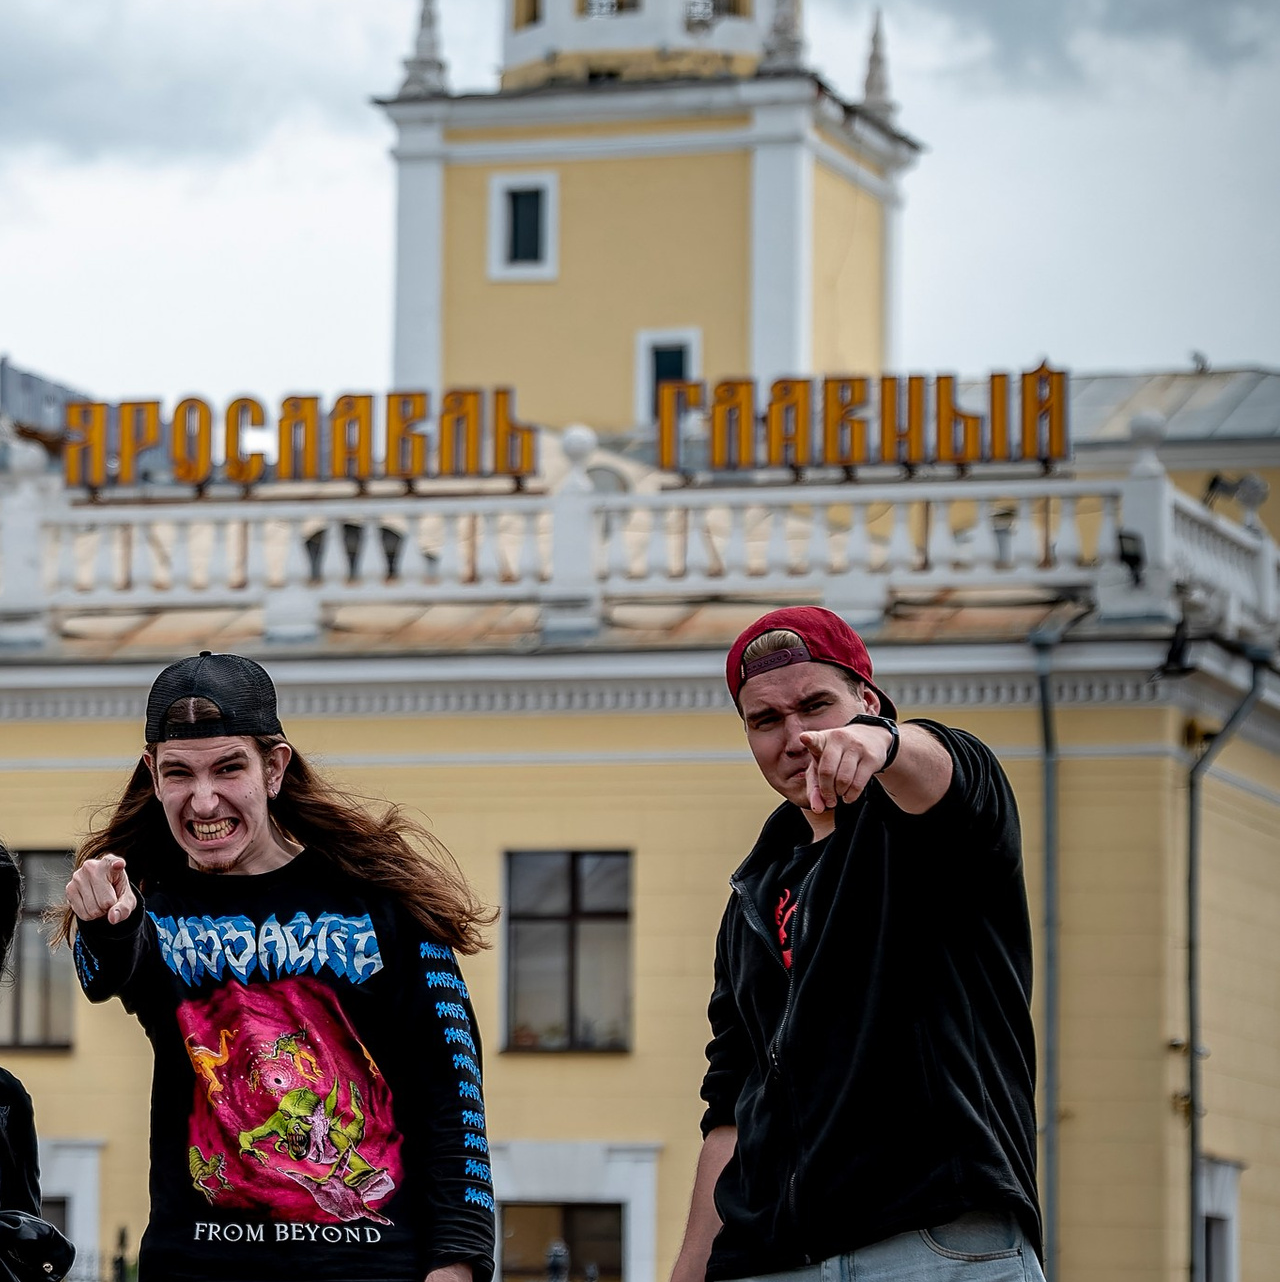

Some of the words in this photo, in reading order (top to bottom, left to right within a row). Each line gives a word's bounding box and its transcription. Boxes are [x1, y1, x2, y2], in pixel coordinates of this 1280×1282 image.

[65, 388, 537, 487] ЯРОСЛАВЛЬ
[658, 359, 1068, 471] ГЛАВНЫЙ
[193, 1222, 265, 1242] FROM
[274, 1222, 382, 1243] BEYOND
